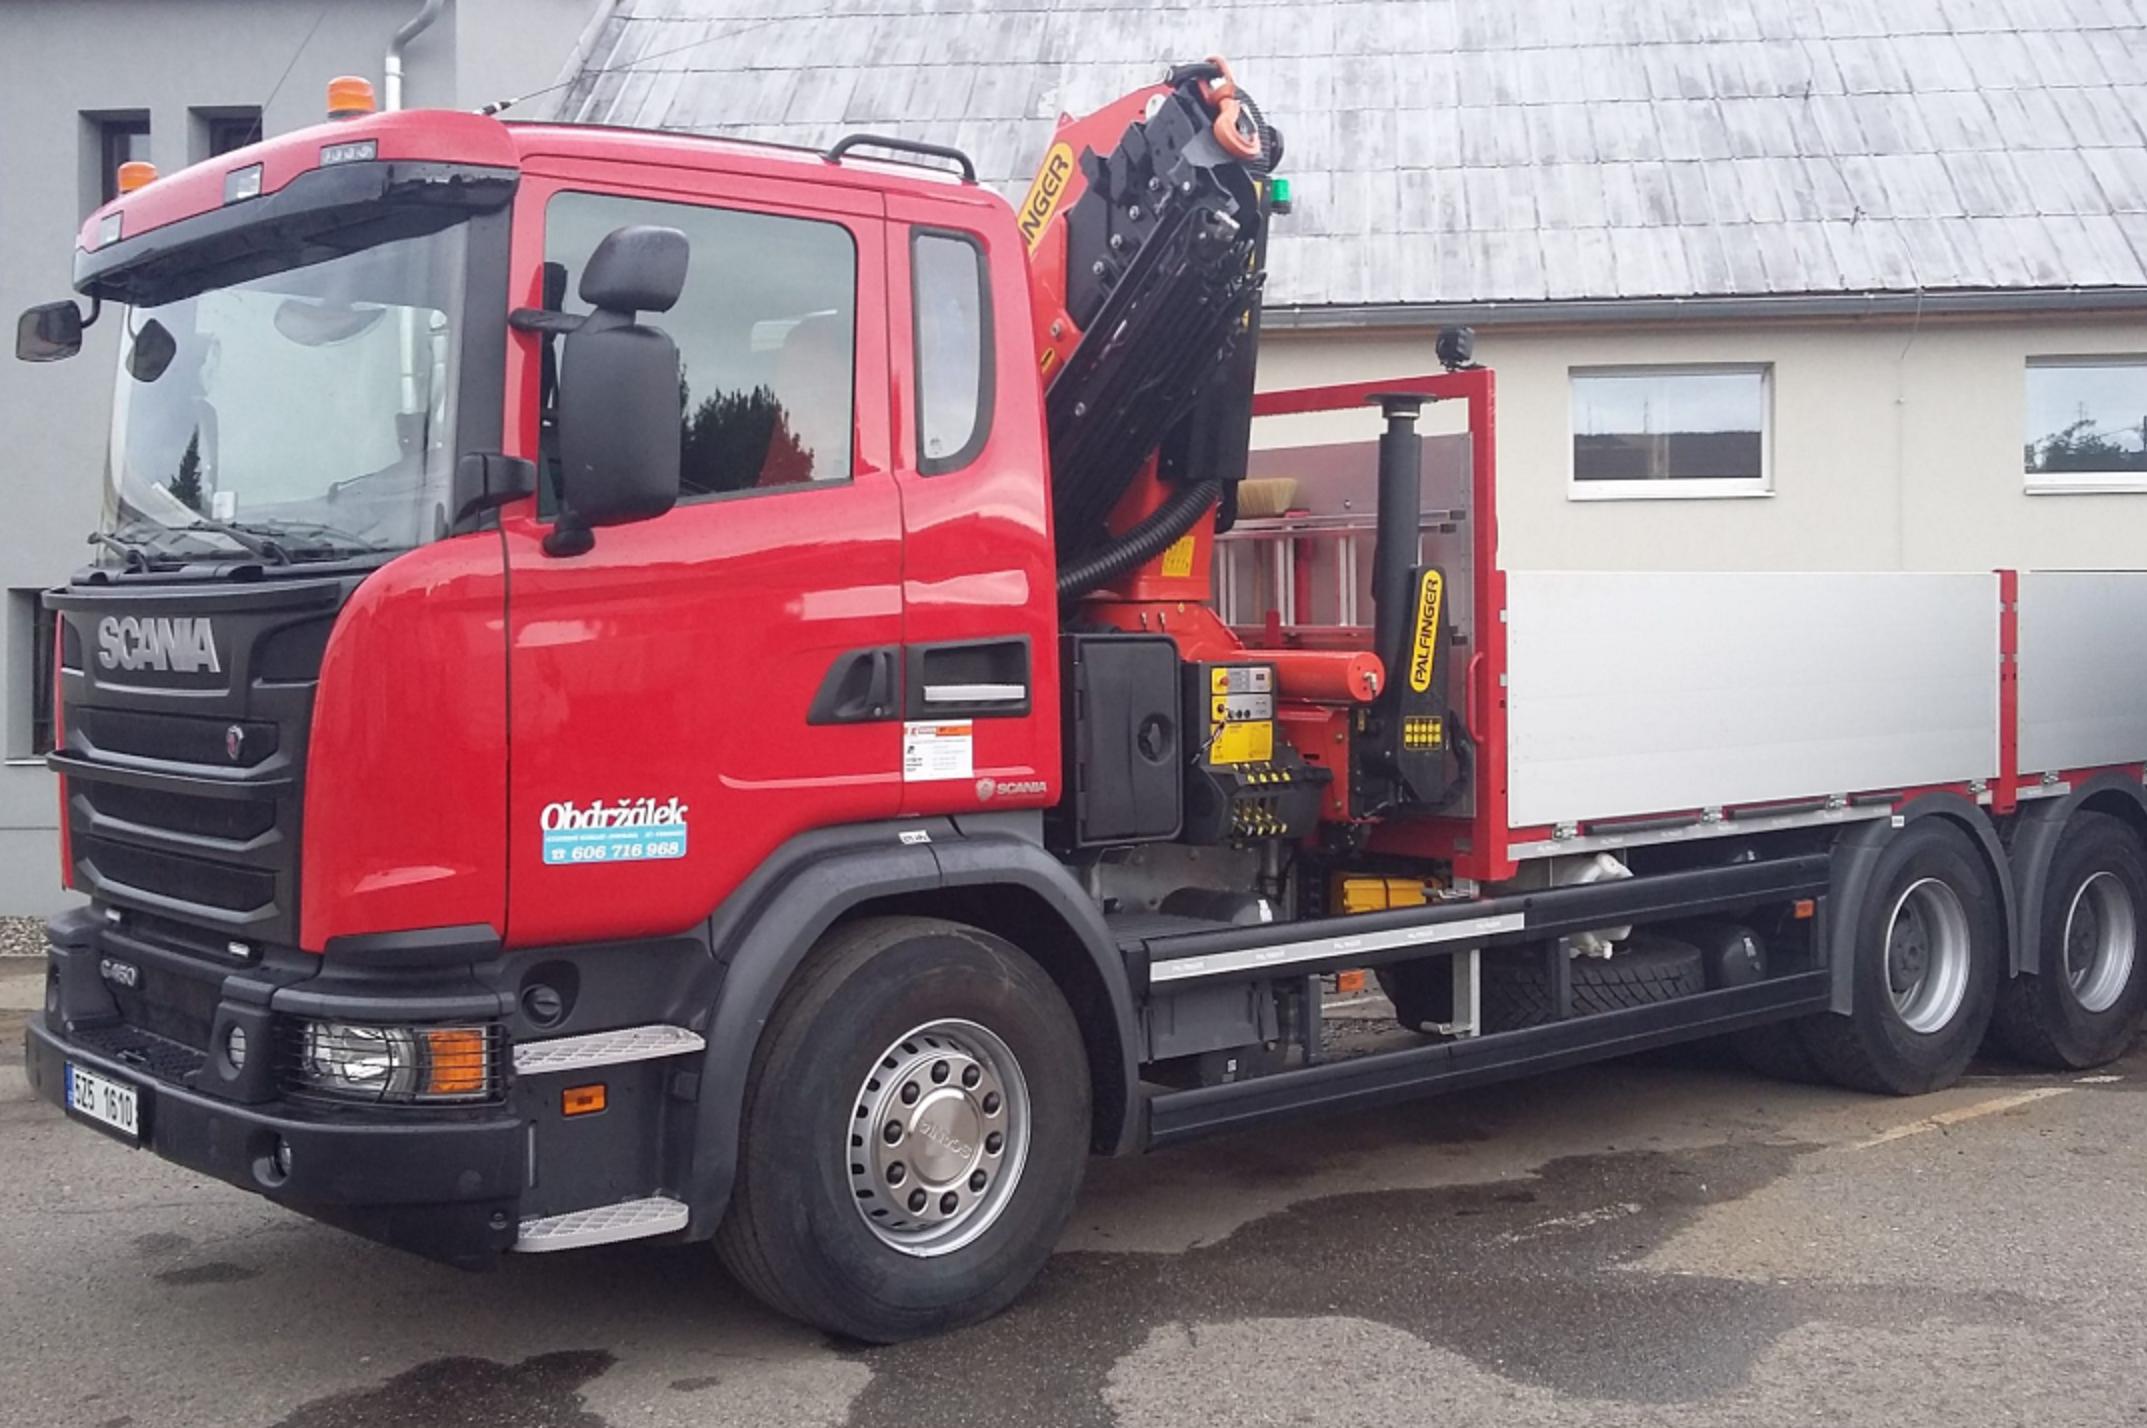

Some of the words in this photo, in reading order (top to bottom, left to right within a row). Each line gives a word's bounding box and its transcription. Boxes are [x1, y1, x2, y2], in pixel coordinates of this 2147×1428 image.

[98, 616, 221, 672] SCANIA
[1415, 579, 1438, 683] PALFINGER
[997, 781, 1047, 795] SCANIA
[540, 797, 689, 831] Obdržálek
[572, 845, 606, 860] 606
[611, 843, 642, 857] 716
[647, 841, 679, 855] 968
[104, 1086, 133, 1127] 1610
